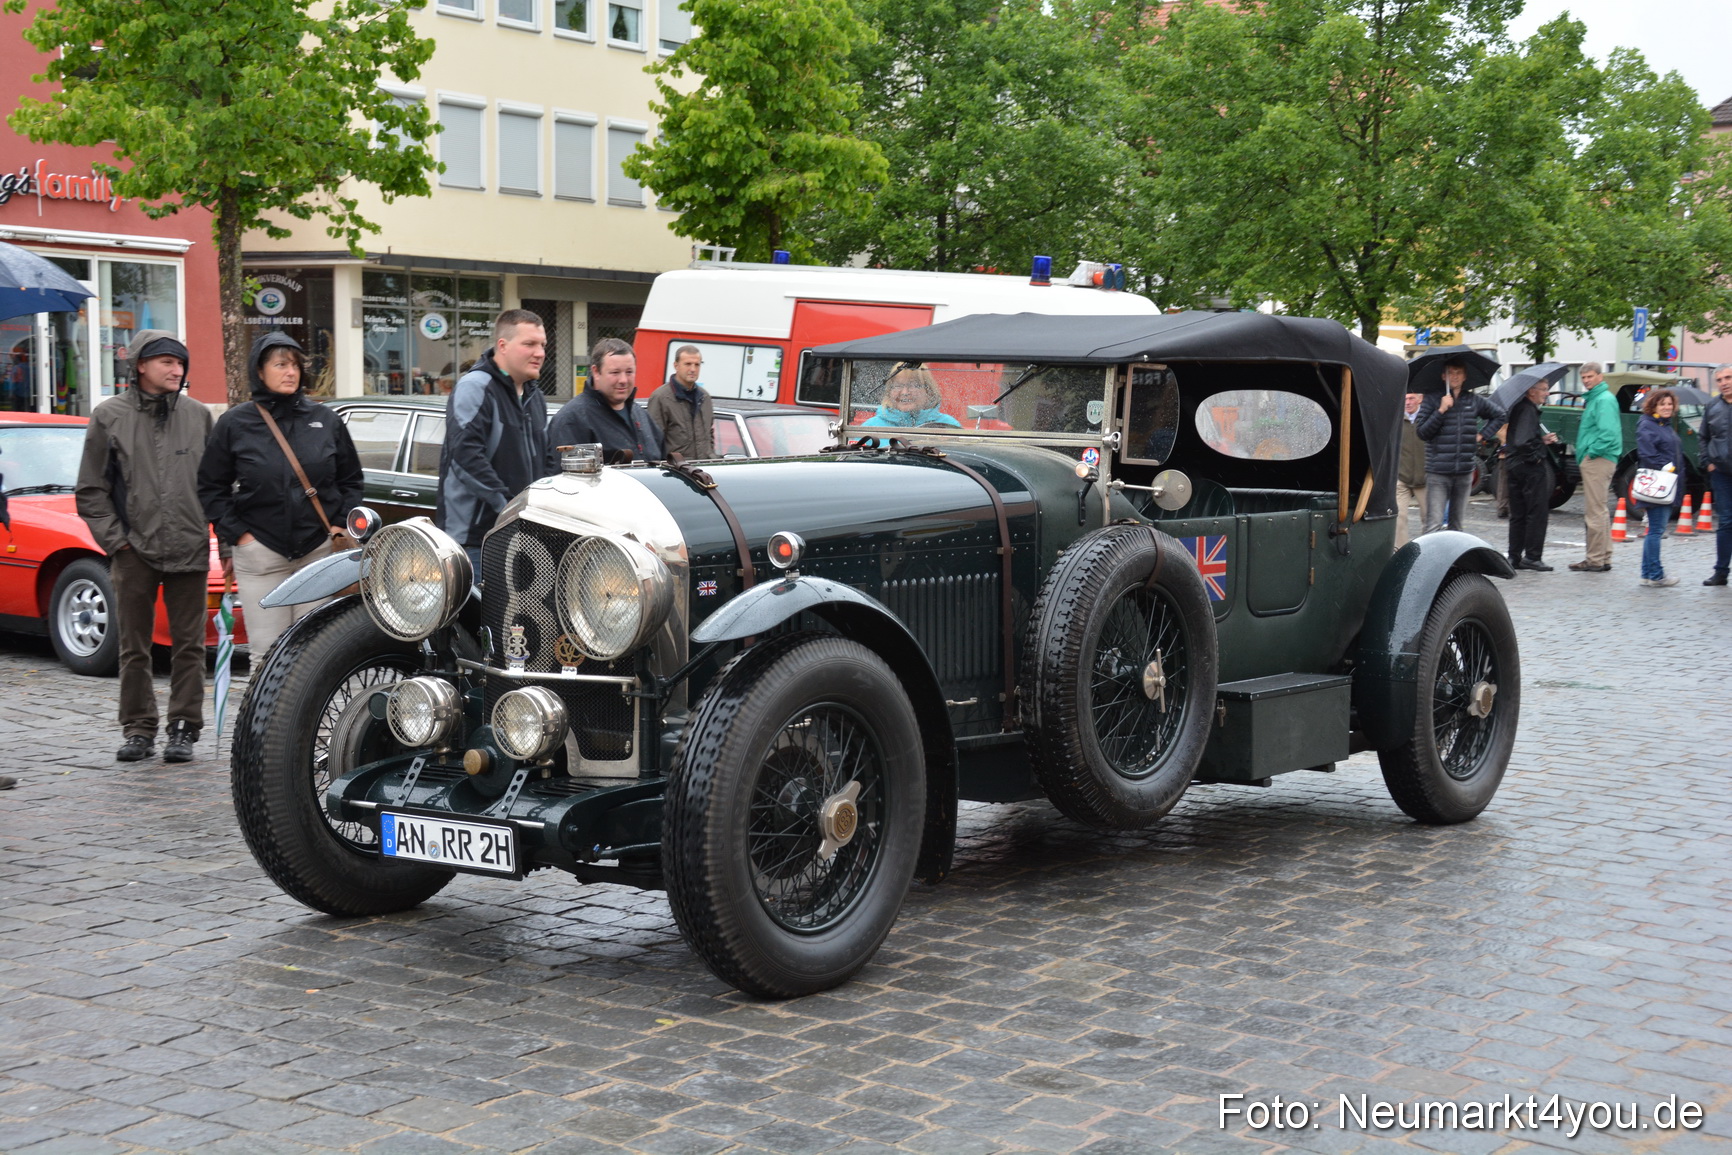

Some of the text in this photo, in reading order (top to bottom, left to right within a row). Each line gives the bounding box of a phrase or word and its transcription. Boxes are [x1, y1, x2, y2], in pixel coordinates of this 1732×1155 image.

[0, 158, 123, 212] g's family
[243, 316, 303, 325] LSBETH MÜLLER
[1635, 312, 1645, 338] P
[386, 838, 393, 848] D
[396, 821, 511, 867] AN RR 2H
